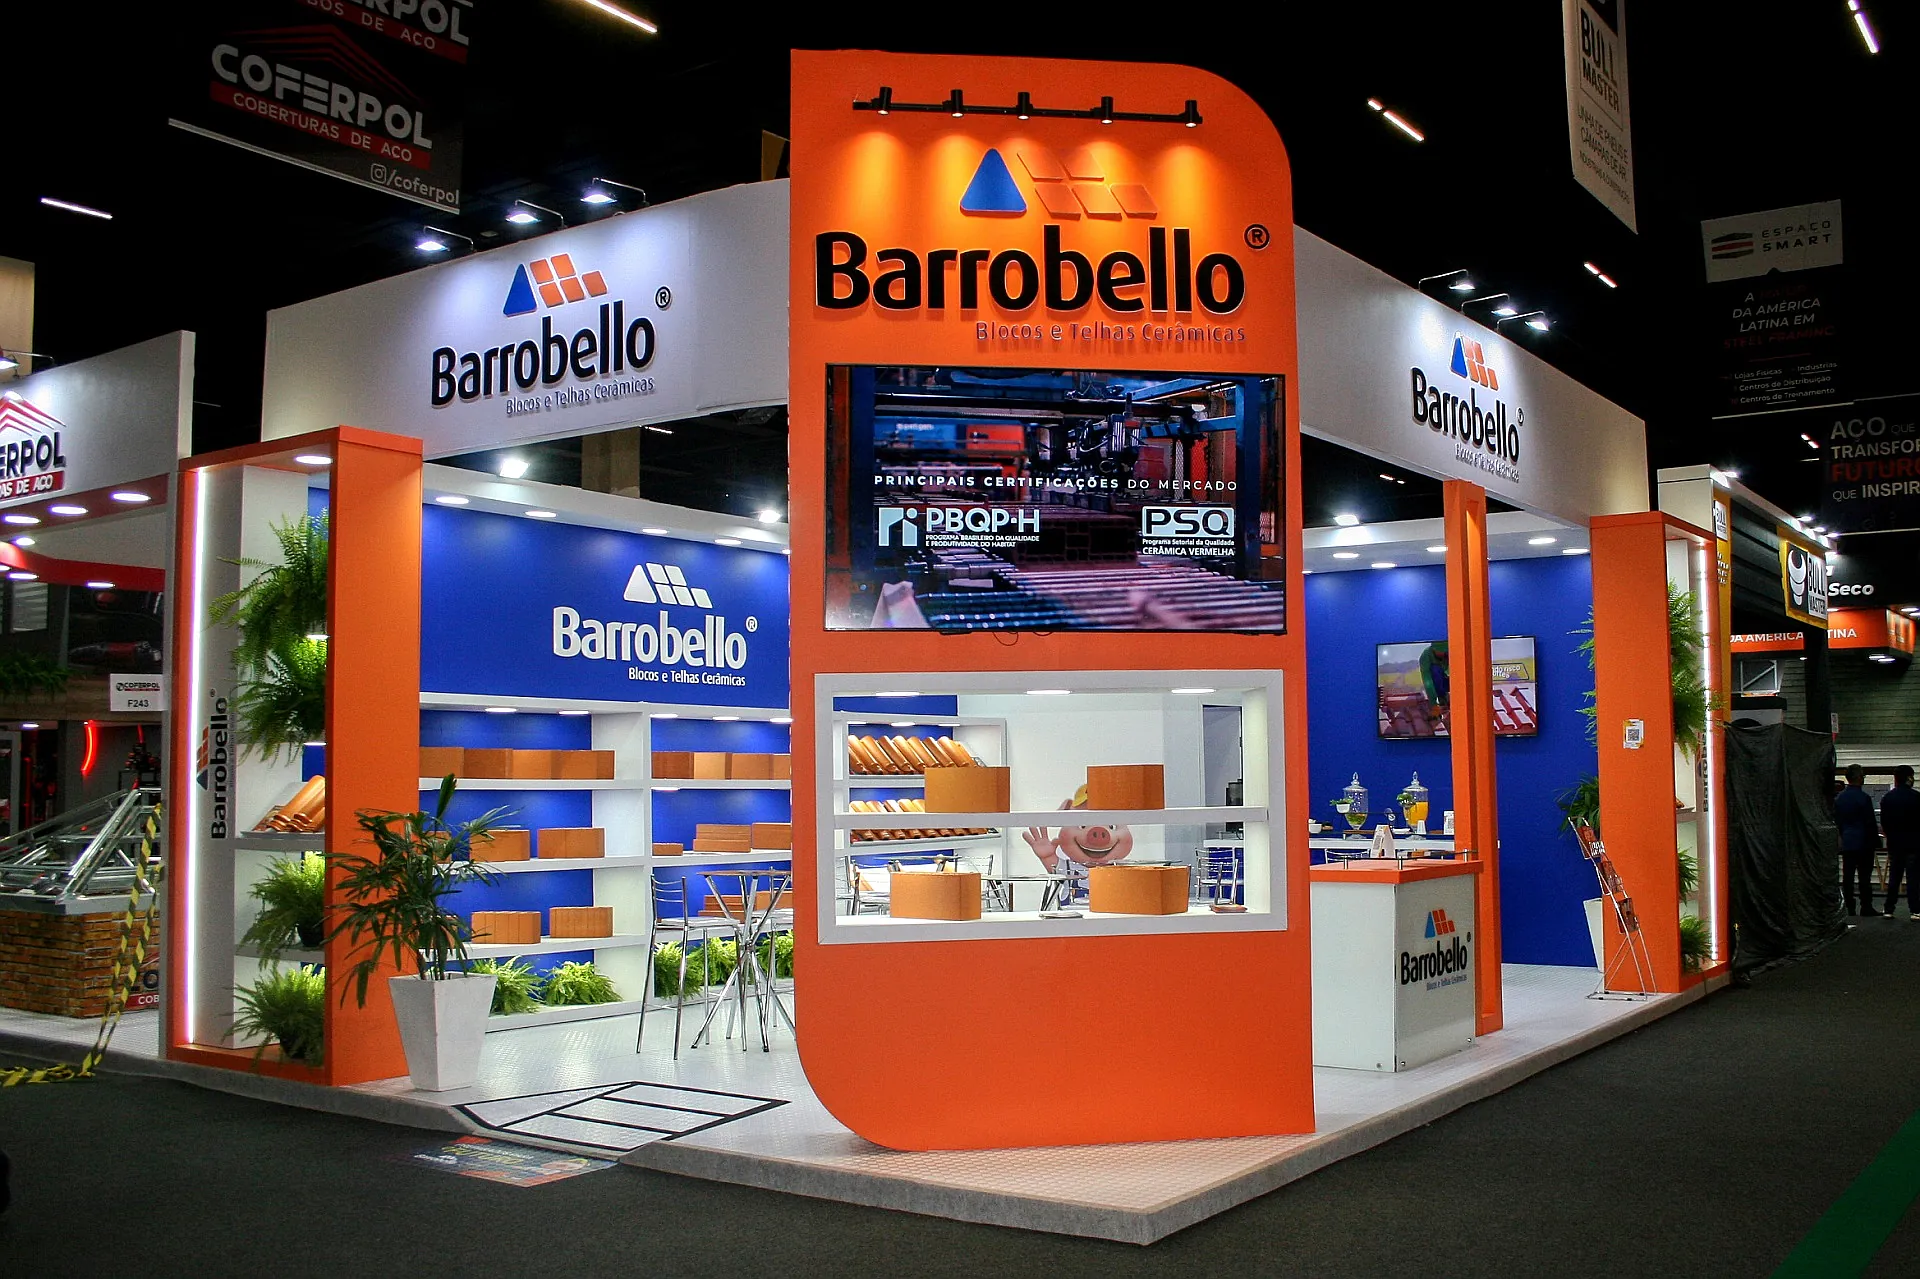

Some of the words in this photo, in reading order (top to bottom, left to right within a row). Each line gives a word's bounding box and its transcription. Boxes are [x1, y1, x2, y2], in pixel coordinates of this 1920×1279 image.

[361, 12, 384, 31] DE
[1580, 8, 1618, 88] BULL
[1582, 57, 1620, 112] MASTER
[211, 44, 432, 149] COFERPOL
[233, 92, 340, 139] COBERTURAS
[351, 131, 371, 149] DE
[1763, 234, 1831, 252] SMART
[816, 225, 1245, 315] Barrobello
[1744, 292, 1755, 303] A
[1732, 307, 1753, 319] DA
[1740, 317, 1790, 332] LATINA
[1793, 313, 1816, 326] EM
[976, 321, 1043, 341] Blocos
[1051, 324, 1063, 341] e
[1071, 321, 1136, 341] Telhas
[1142, 320, 1246, 342] Cerâmicas
[431, 300, 655, 406] Barrobello
[506, 394, 541, 415] Blocos
[545, 394, 552, 408] e
[555, 386, 591, 406] Telhas
[1411, 367, 1520, 464] Barrobello
[1831, 416, 1887, 442] AÇO
[1891, 421, 1916, 436] QUE
[16, 479, 30, 494] DE
[874, 475, 975, 487] PRINCIPAIS
[984, 476, 1119, 491] CERTIFICAÇÕES
[1128, 479, 1150, 489] DO
[1159, 479, 1237, 491] MERCADO
[1833, 489, 1857, 502] QUE
[1145, 508, 1230, 536] PSQ
[1142, 538, 1171, 546] Programa
[1205, 539, 1235, 547] Qualidade
[1142, 545, 1187, 556] CERÂMICA
[1188, 547, 1235, 556] VERMELHA
[1828, 582, 1874, 597] Seco
[553, 606, 747, 669] Barrobello
[628, 667, 659, 682] Blocos
[661, 672, 668, 683] e
[670, 669, 700, 684] Telhas
[702, 672, 746, 687] Cerâmicas
[127, 699, 149, 708] F243
[210, 697, 229, 838] Barrobello
[1401, 936, 1467, 985] Barrobello
